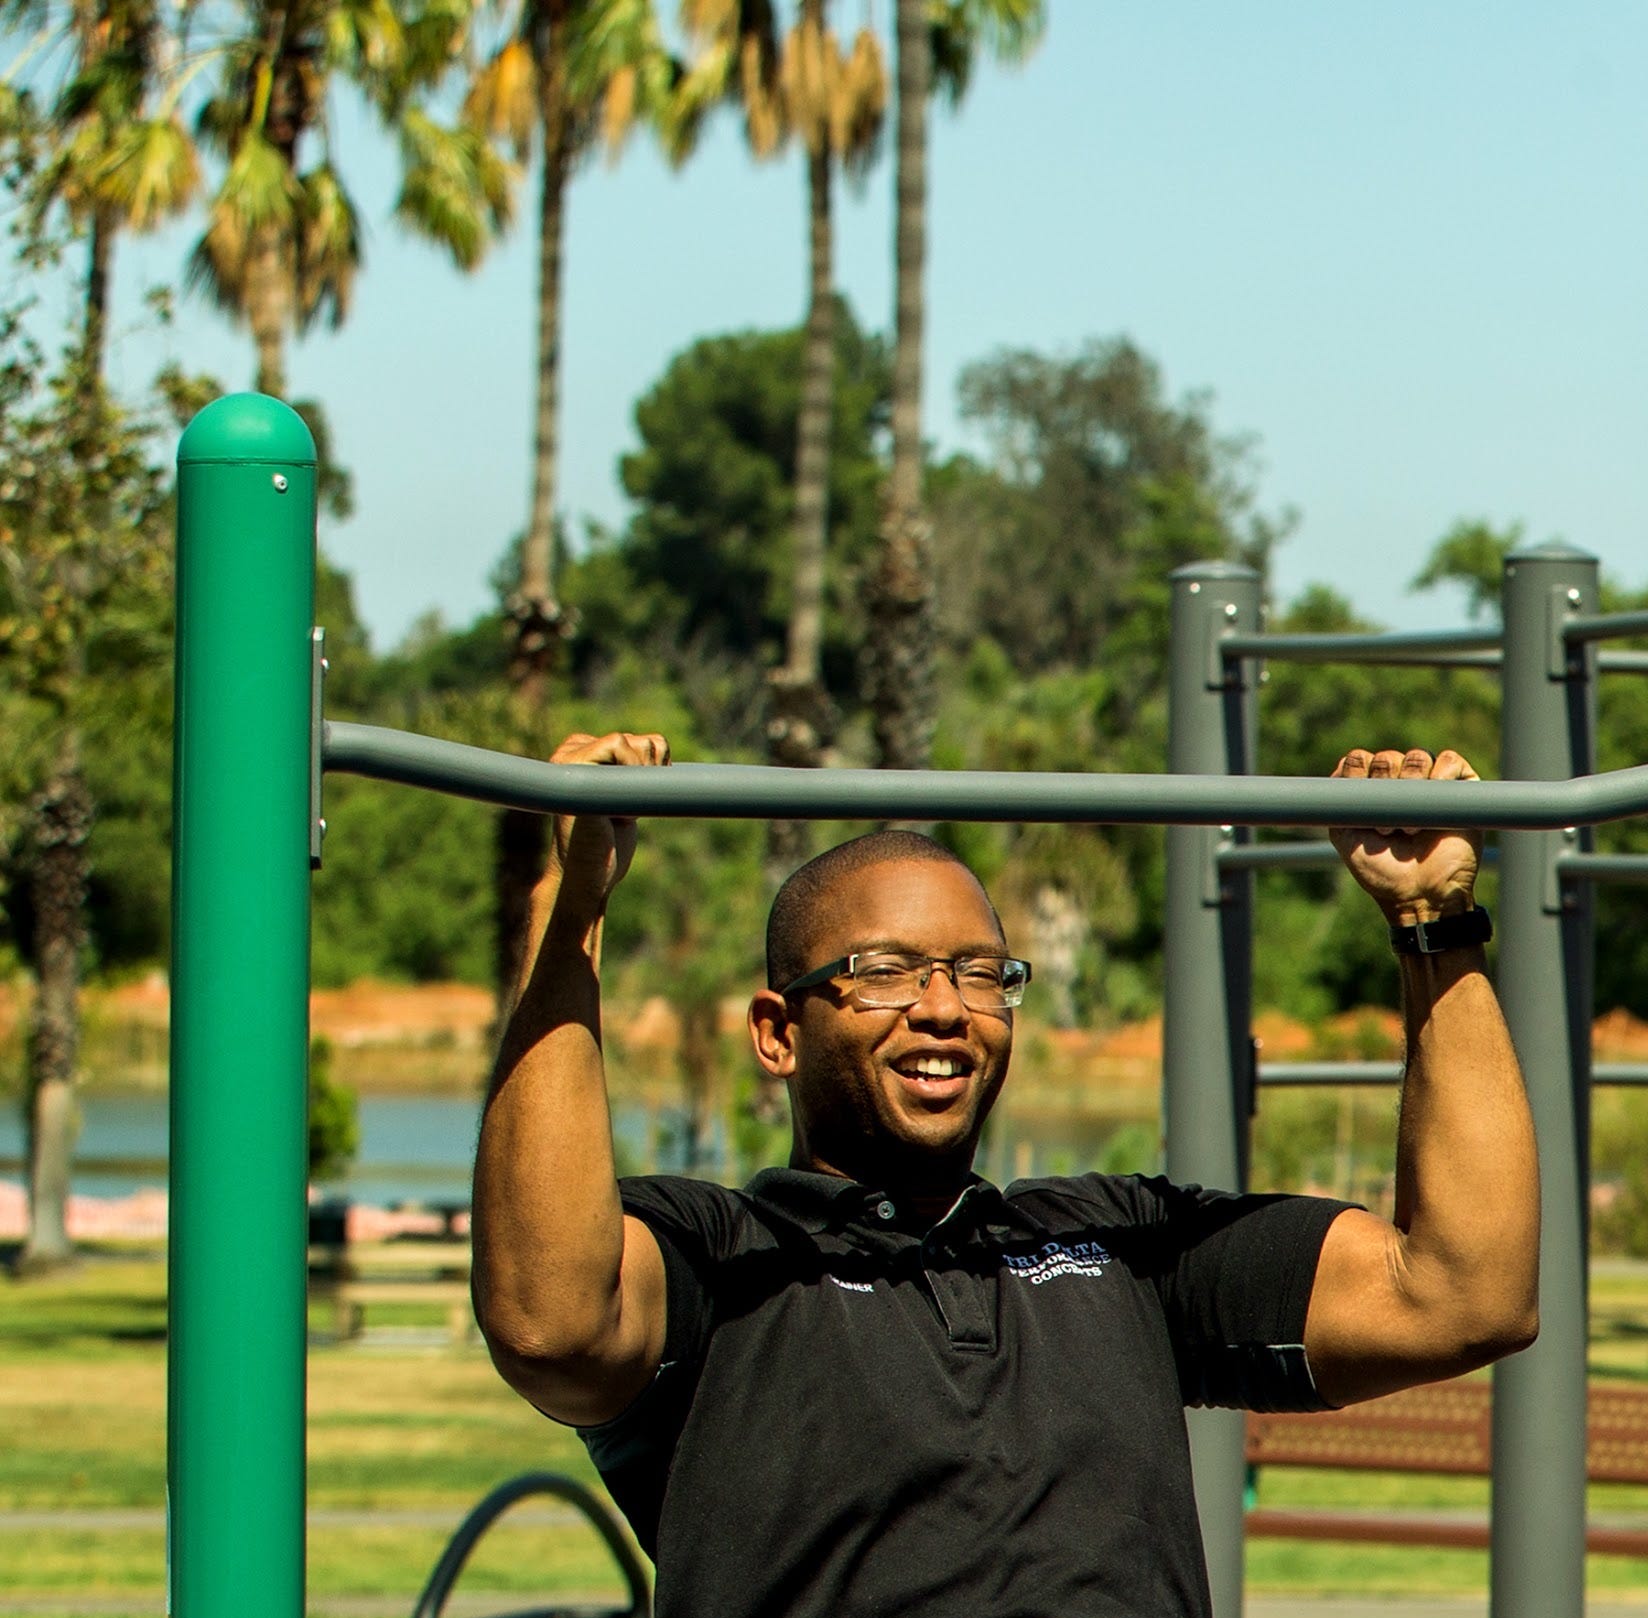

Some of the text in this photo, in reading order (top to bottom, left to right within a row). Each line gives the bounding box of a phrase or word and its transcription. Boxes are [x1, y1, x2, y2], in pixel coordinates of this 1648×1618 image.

[1001, 1241, 1106, 1268] TRI DLTA
[1008, 1252, 1113, 1278] ERFORNCE
[1030, 1262, 1103, 1285] CONCETS
